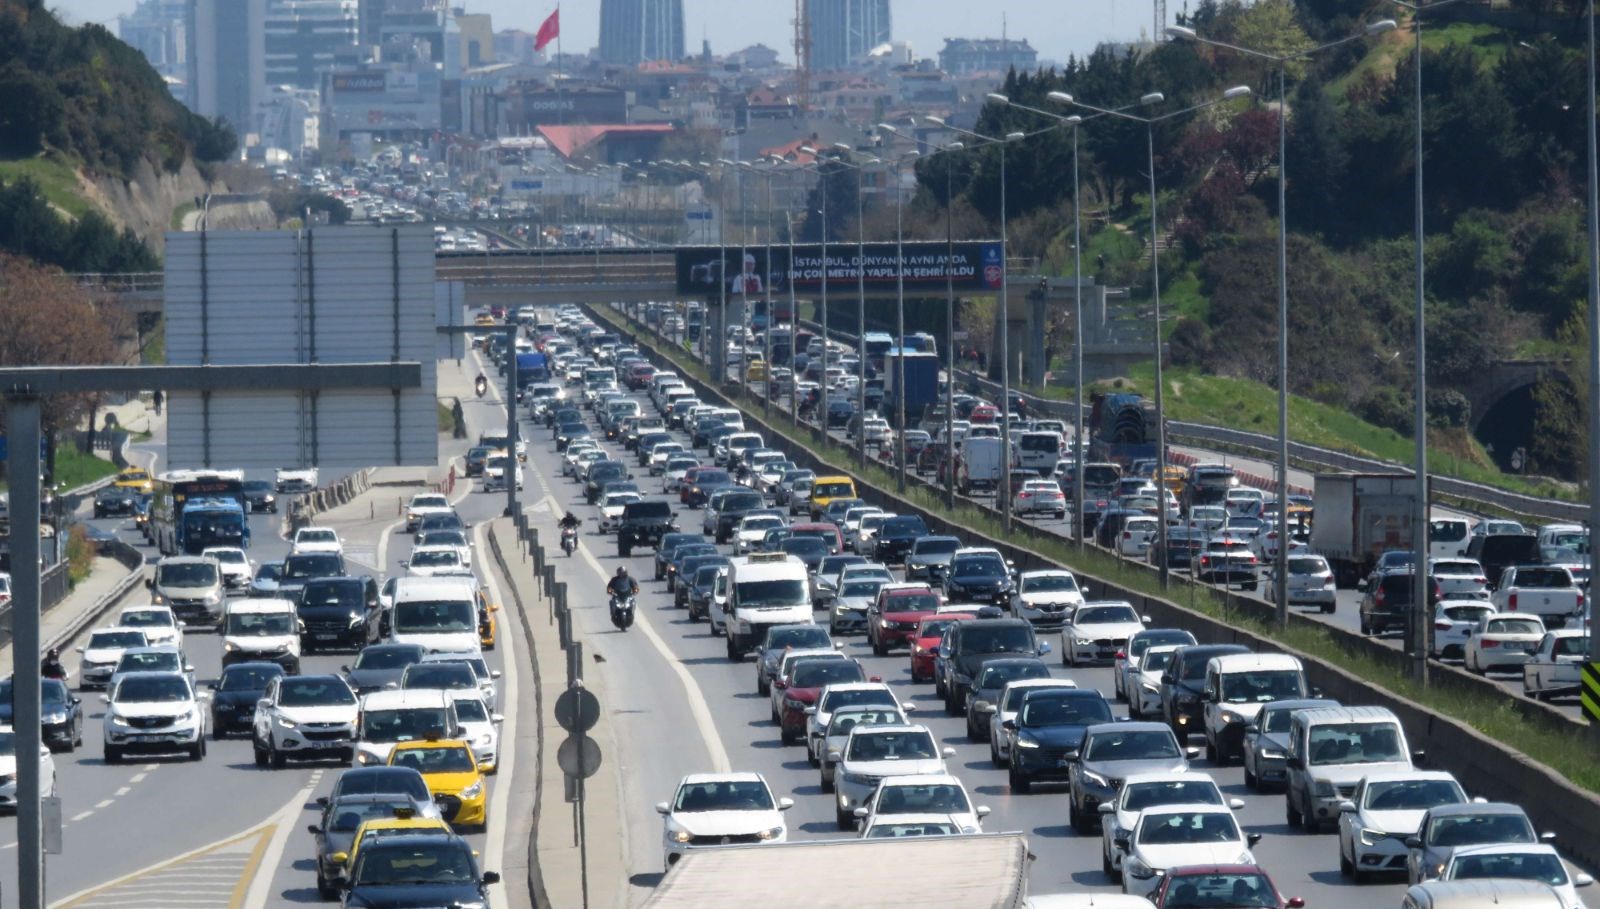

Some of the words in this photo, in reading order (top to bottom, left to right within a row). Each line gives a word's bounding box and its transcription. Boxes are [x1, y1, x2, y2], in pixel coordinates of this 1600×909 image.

[533, 99, 575, 111] DOĞAŞ
[909, 255, 934, 266] AYNI
[828, 268, 865, 278] METRO
[913, 266, 944, 278] ŞEHRİ
[945, 266, 975, 276] OLDU
